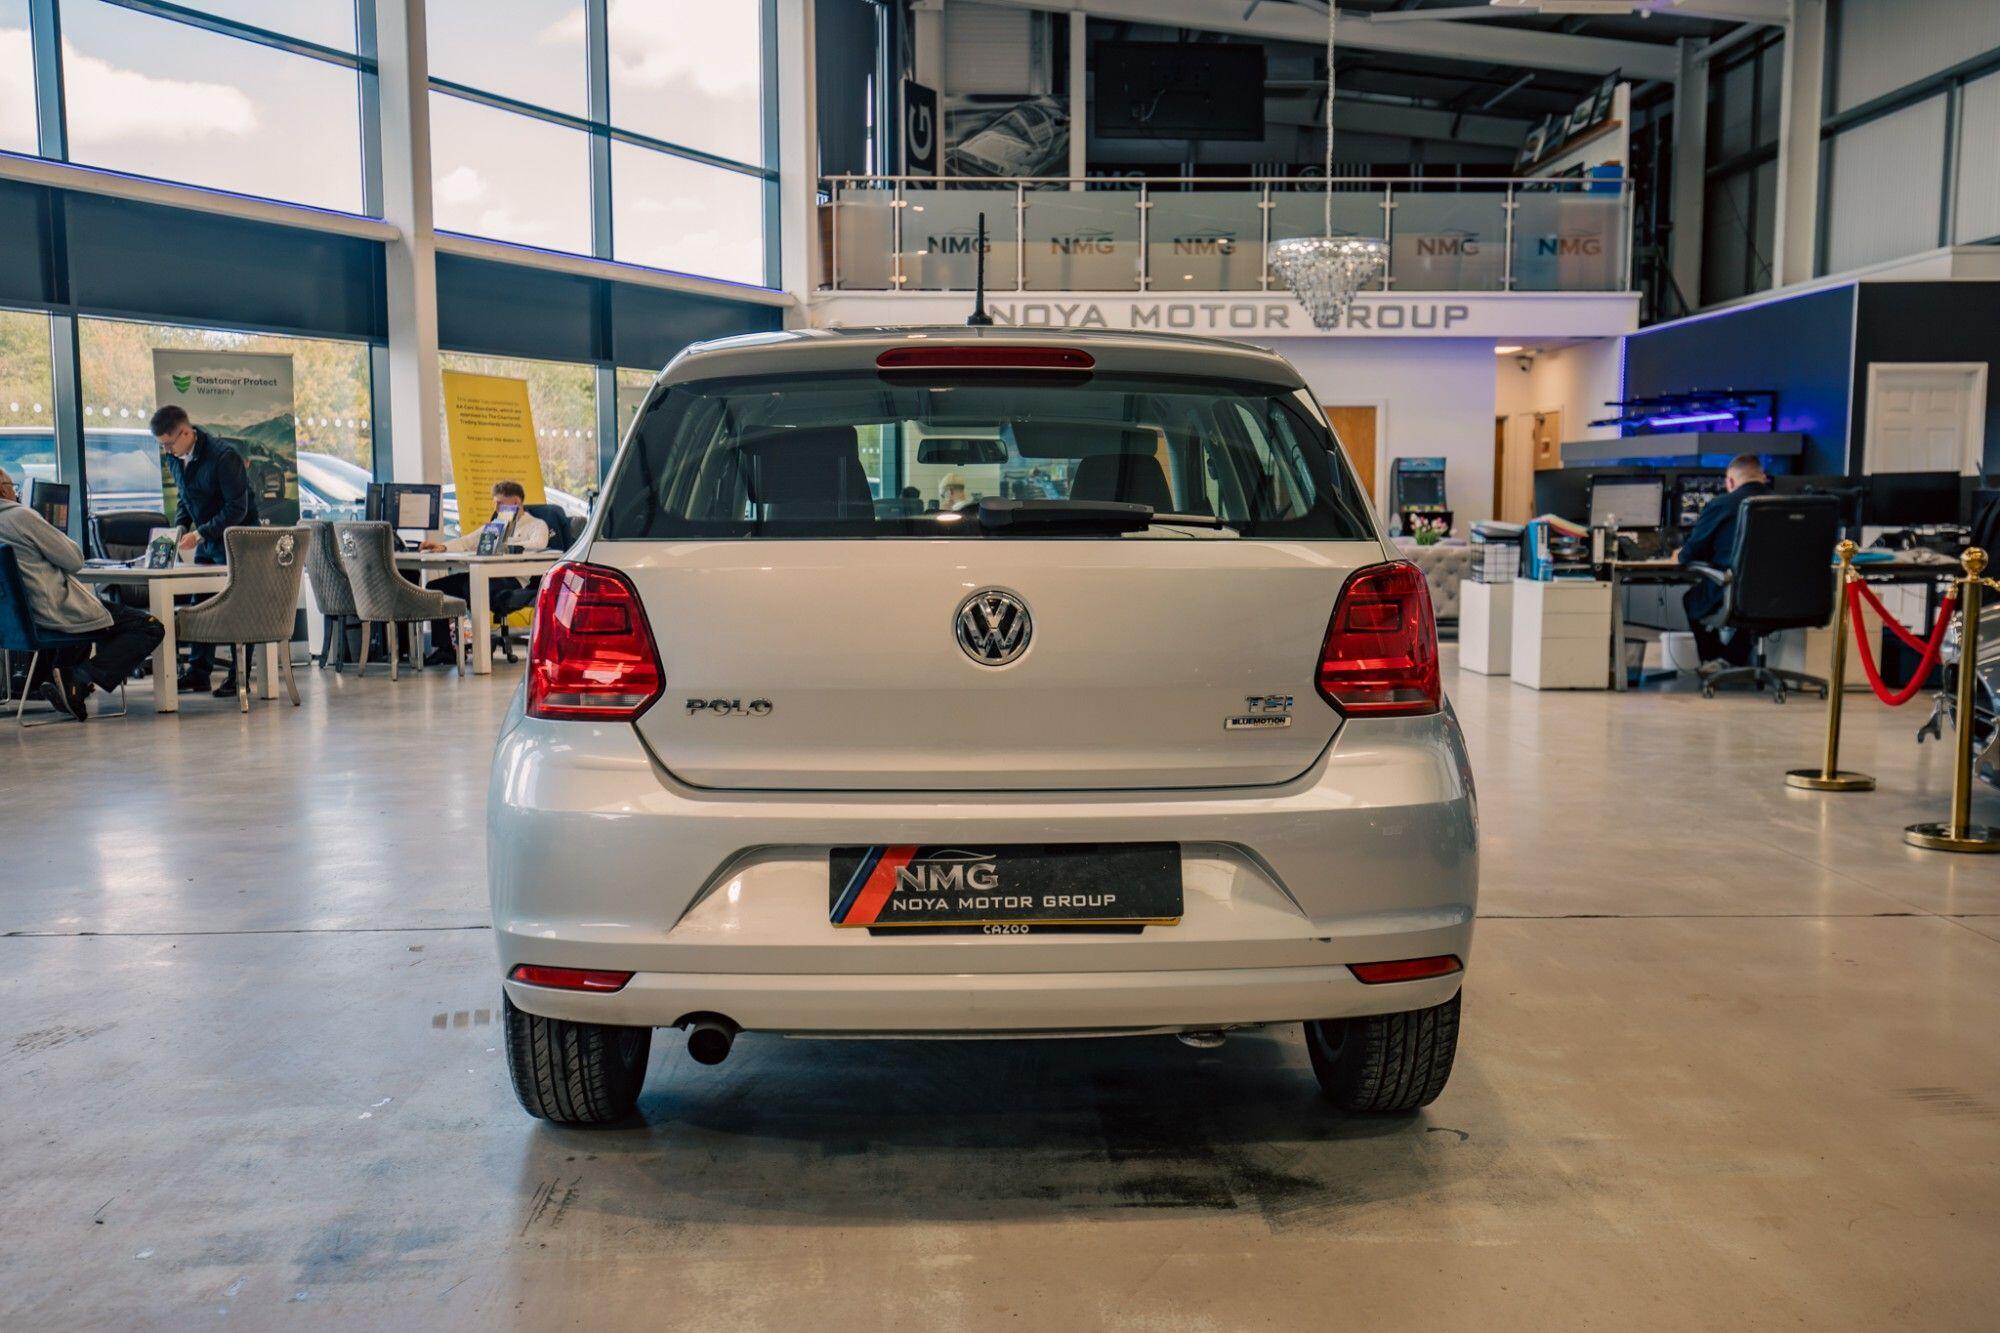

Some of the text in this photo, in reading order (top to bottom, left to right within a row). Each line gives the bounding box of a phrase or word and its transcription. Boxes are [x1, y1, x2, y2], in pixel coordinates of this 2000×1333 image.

[927, 236, 991, 254] NMG
[1051, 237, 1115, 255] NMG
[1173, 237, 1237, 256] NMG
[1416, 238, 1480, 256] NMG
[1538, 238, 1602, 256] NMG
[989, 304, 1470, 329] NOYA MOTOR ROUP
[196, 376, 277, 386] Customer Protect
[197, 387, 235, 395] Warranty
[685, 698, 773, 717] POLO
[1245, 695, 1294, 713] TSI
[1231, 717, 1286, 726] BLUEMOTION
[894, 862, 999, 892] NMG
[892, 894, 1117, 911] NOYA MOTOR GROUP
[982, 924, 1031, 935] CAZOO
